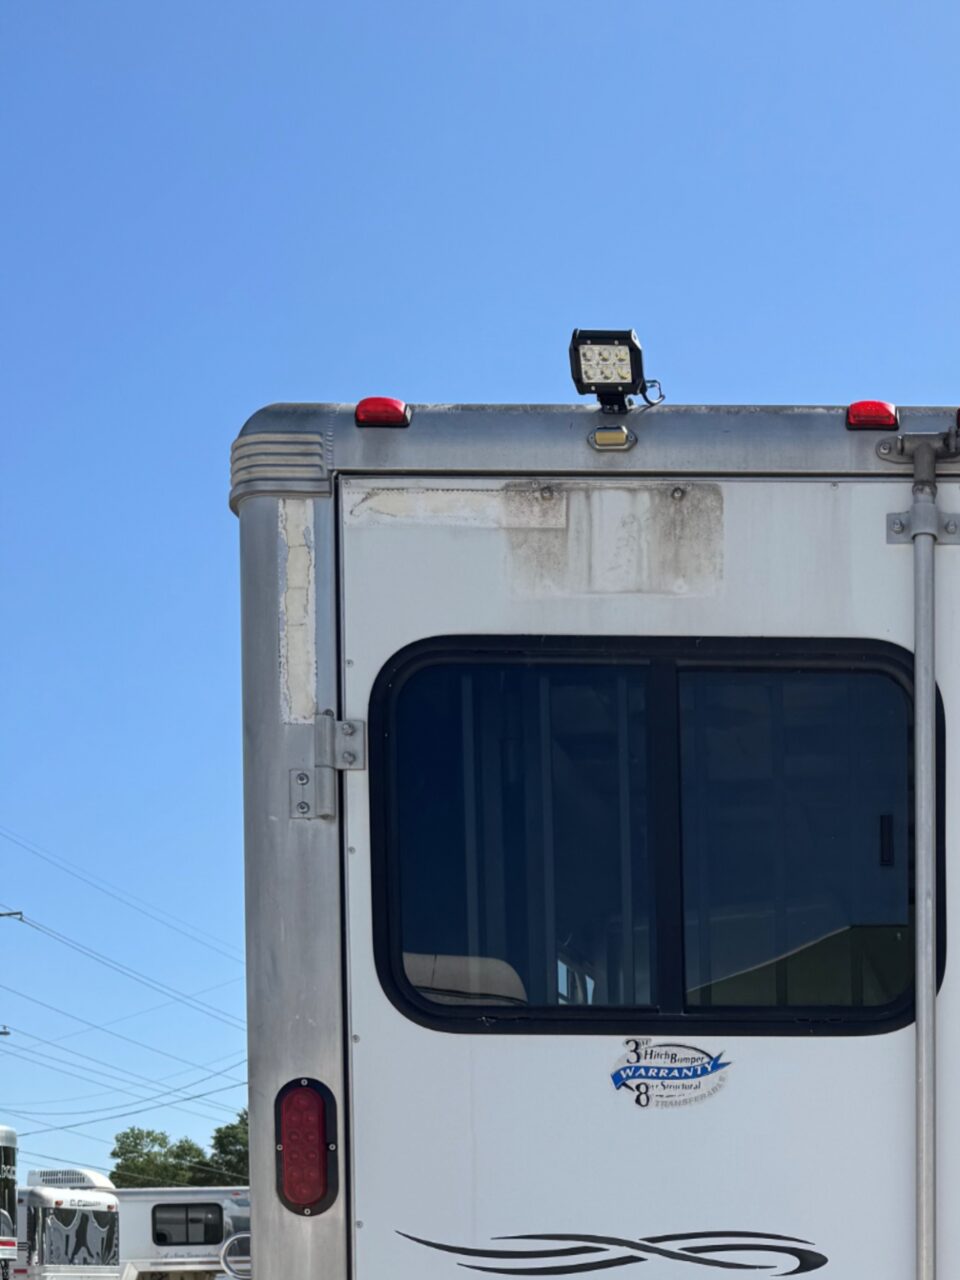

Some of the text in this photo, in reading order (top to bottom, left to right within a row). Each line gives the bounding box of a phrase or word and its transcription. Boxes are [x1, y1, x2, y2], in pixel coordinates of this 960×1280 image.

[626, 1039, 641, 1065] 3
[620, 1060, 714, 1079] WARRANTY
[635, 1082, 650, 1107] 8
